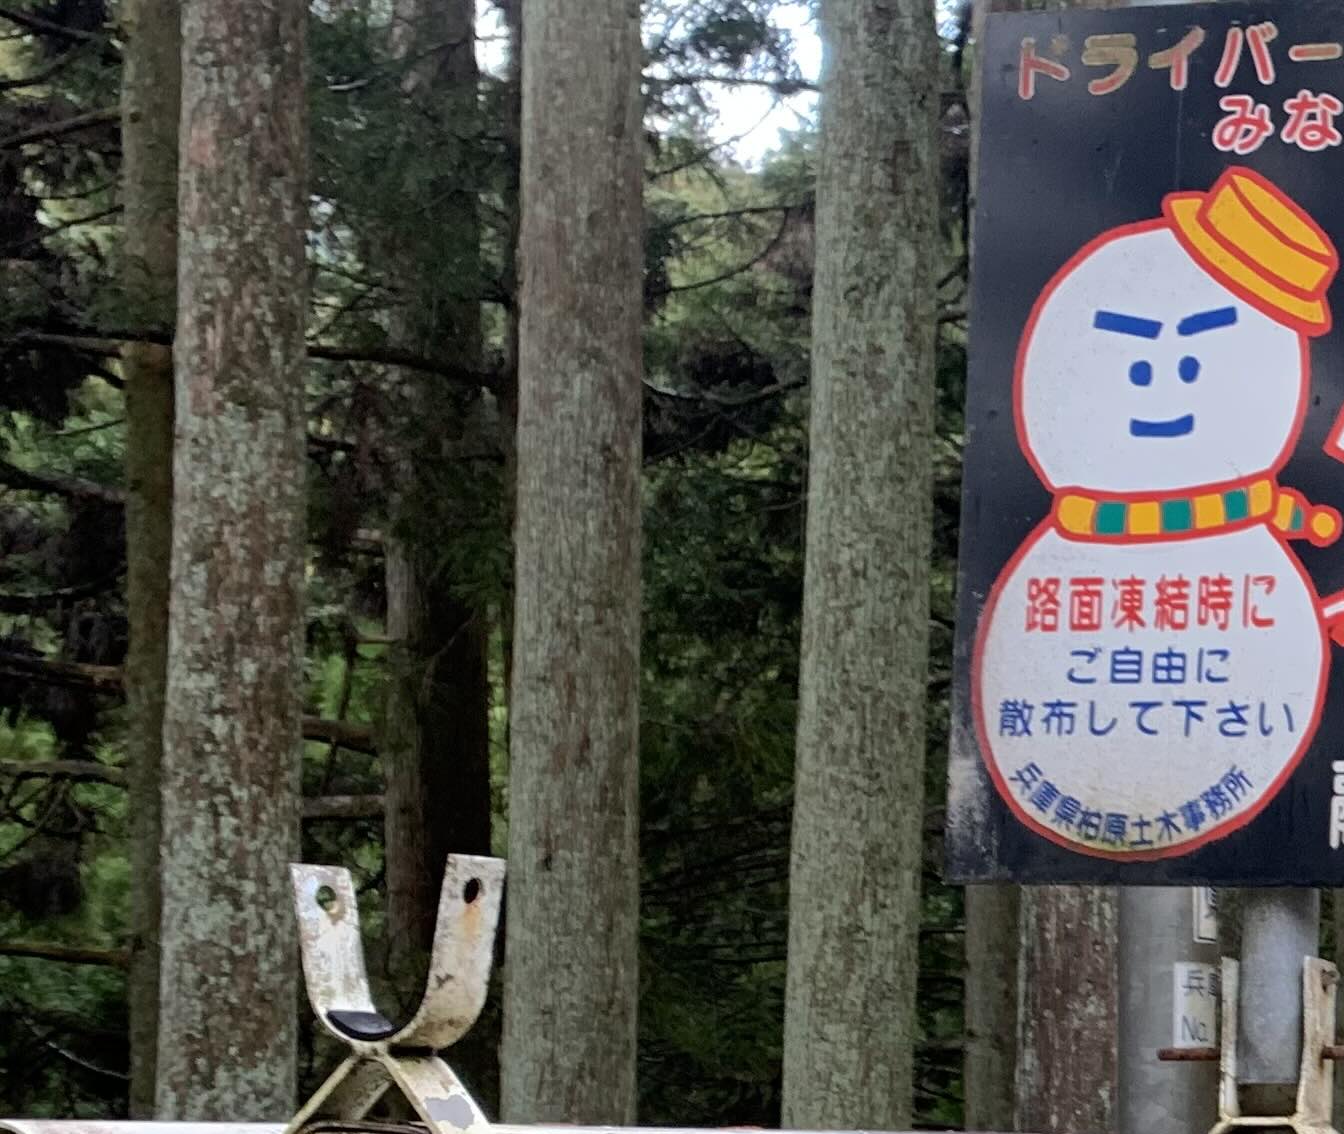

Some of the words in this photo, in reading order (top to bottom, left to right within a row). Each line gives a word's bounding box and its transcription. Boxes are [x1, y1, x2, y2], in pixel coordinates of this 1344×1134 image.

[1024, 573, 1277, 634] 路面凍結時に
[1065, 645, 1231, 685] ご自由に
[999, 699, 1295, 738] 散布して下さい
[1008, 762, 1255, 848] 兵庫県柏原土木事務所
